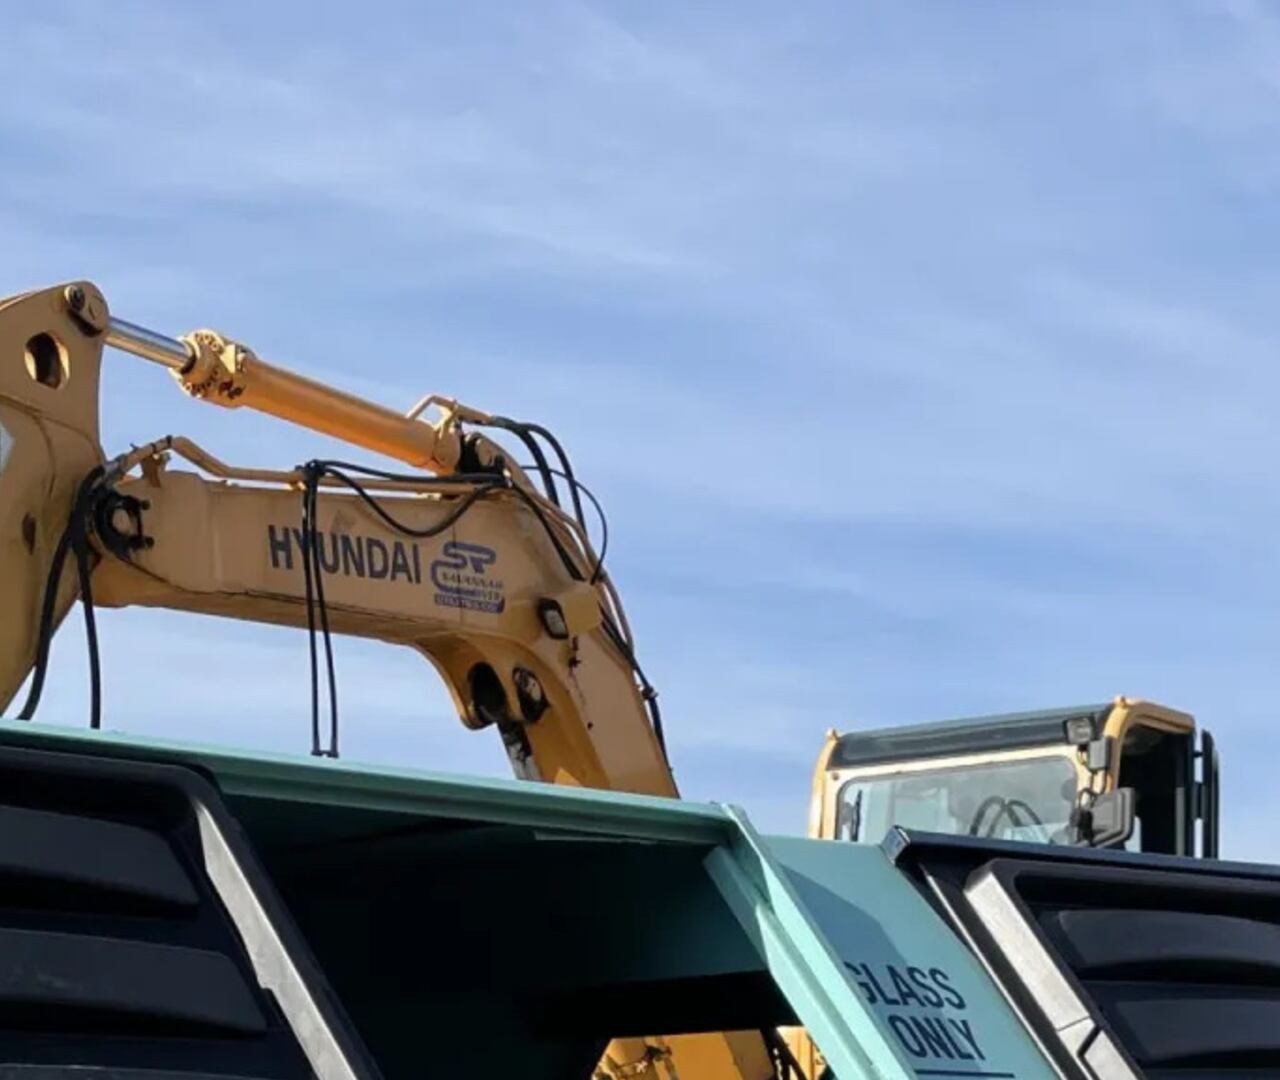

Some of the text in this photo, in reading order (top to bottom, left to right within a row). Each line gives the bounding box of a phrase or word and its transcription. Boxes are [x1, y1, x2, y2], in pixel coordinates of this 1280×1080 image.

[268, 524, 421, 584] HYUNDAI
[843, 961, 966, 1010] GLASS
[887, 1014, 986, 1060] ONLY
